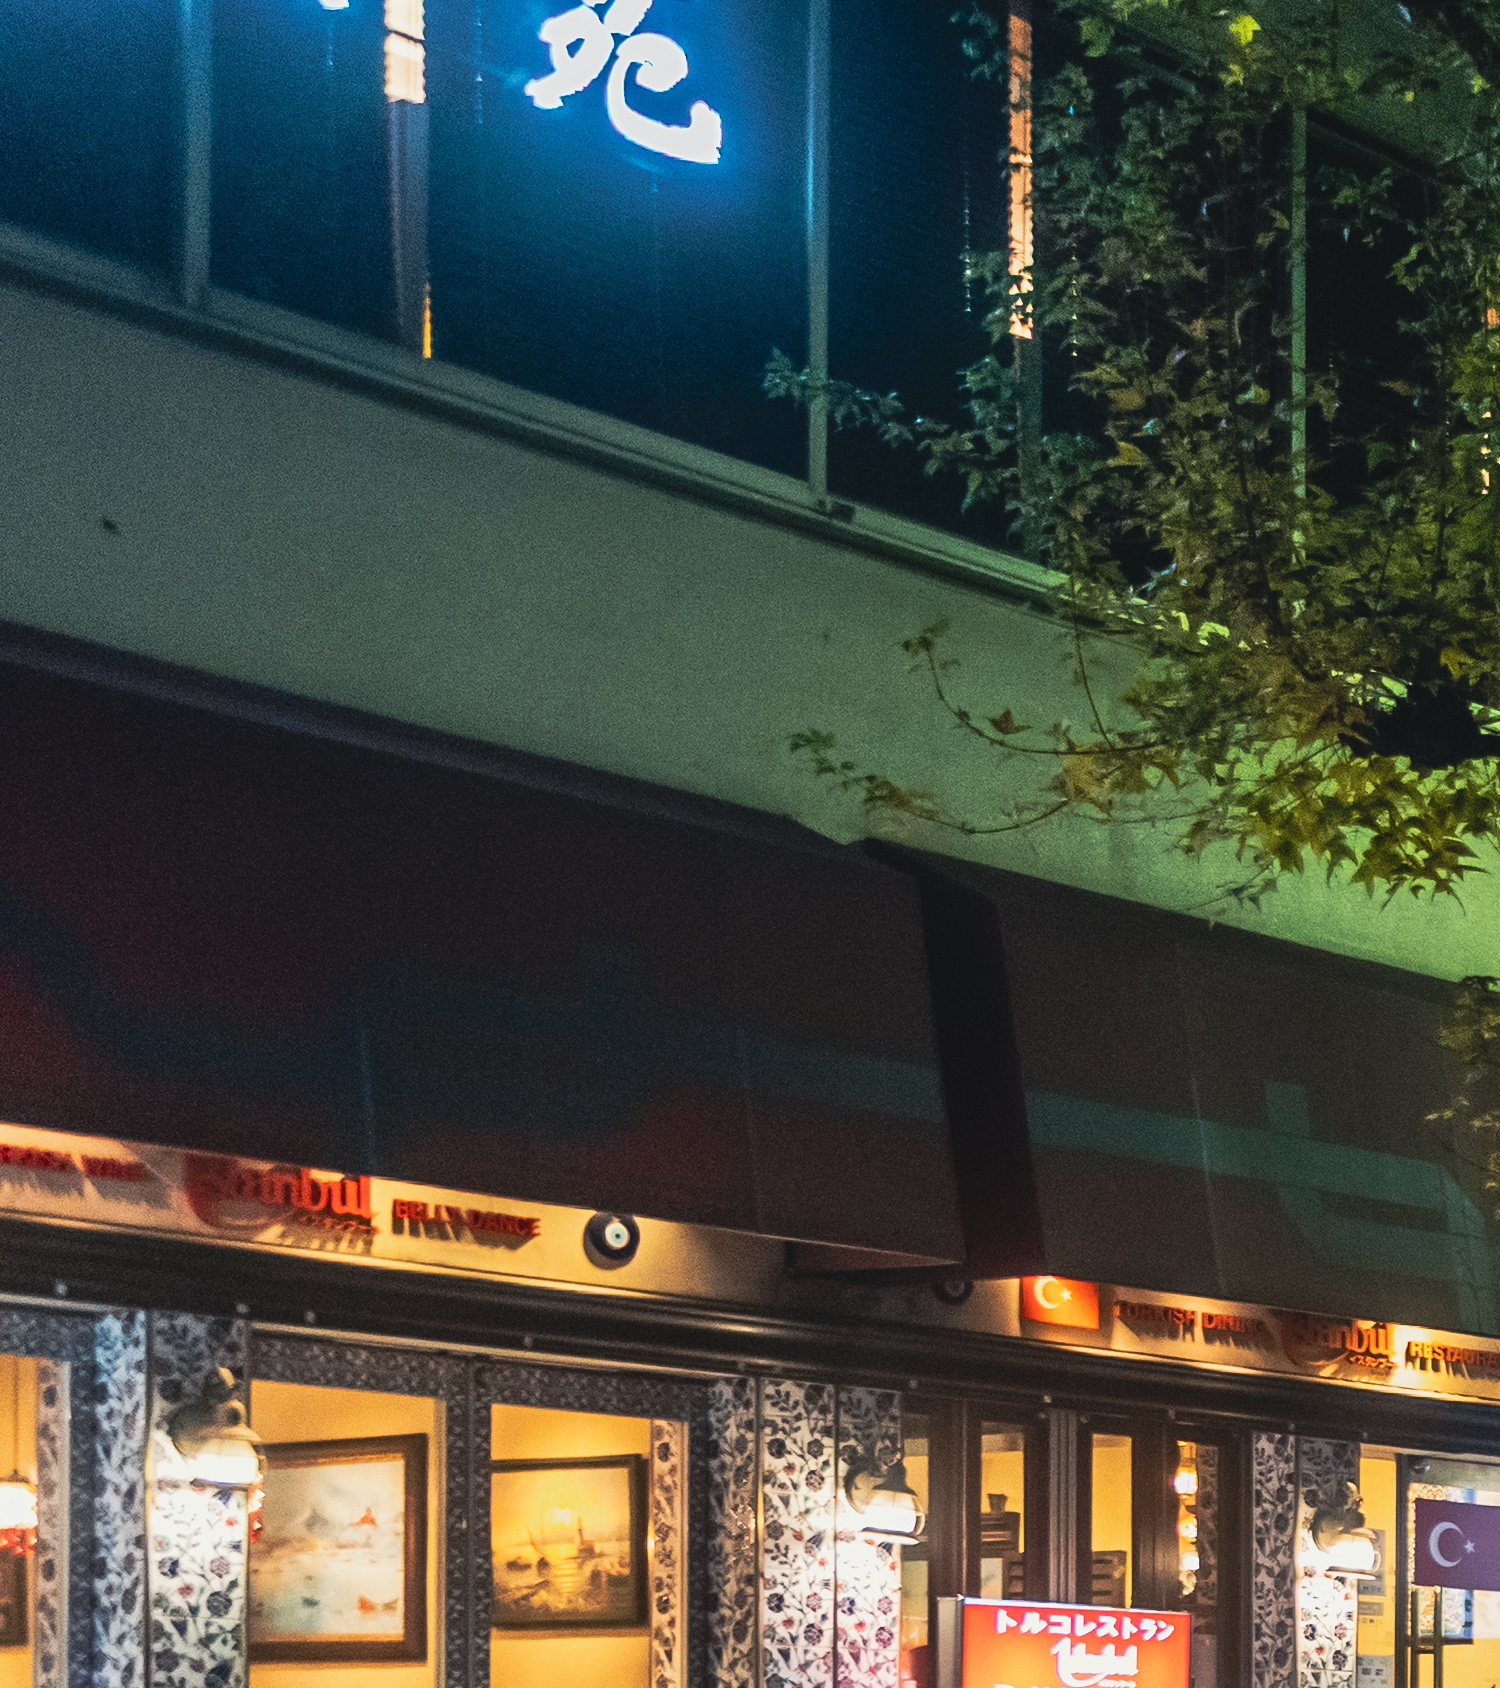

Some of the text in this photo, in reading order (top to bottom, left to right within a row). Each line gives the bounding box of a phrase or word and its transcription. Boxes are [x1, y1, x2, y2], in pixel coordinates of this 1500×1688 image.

[995, 1608, 1175, 1642] トルコレストラン
